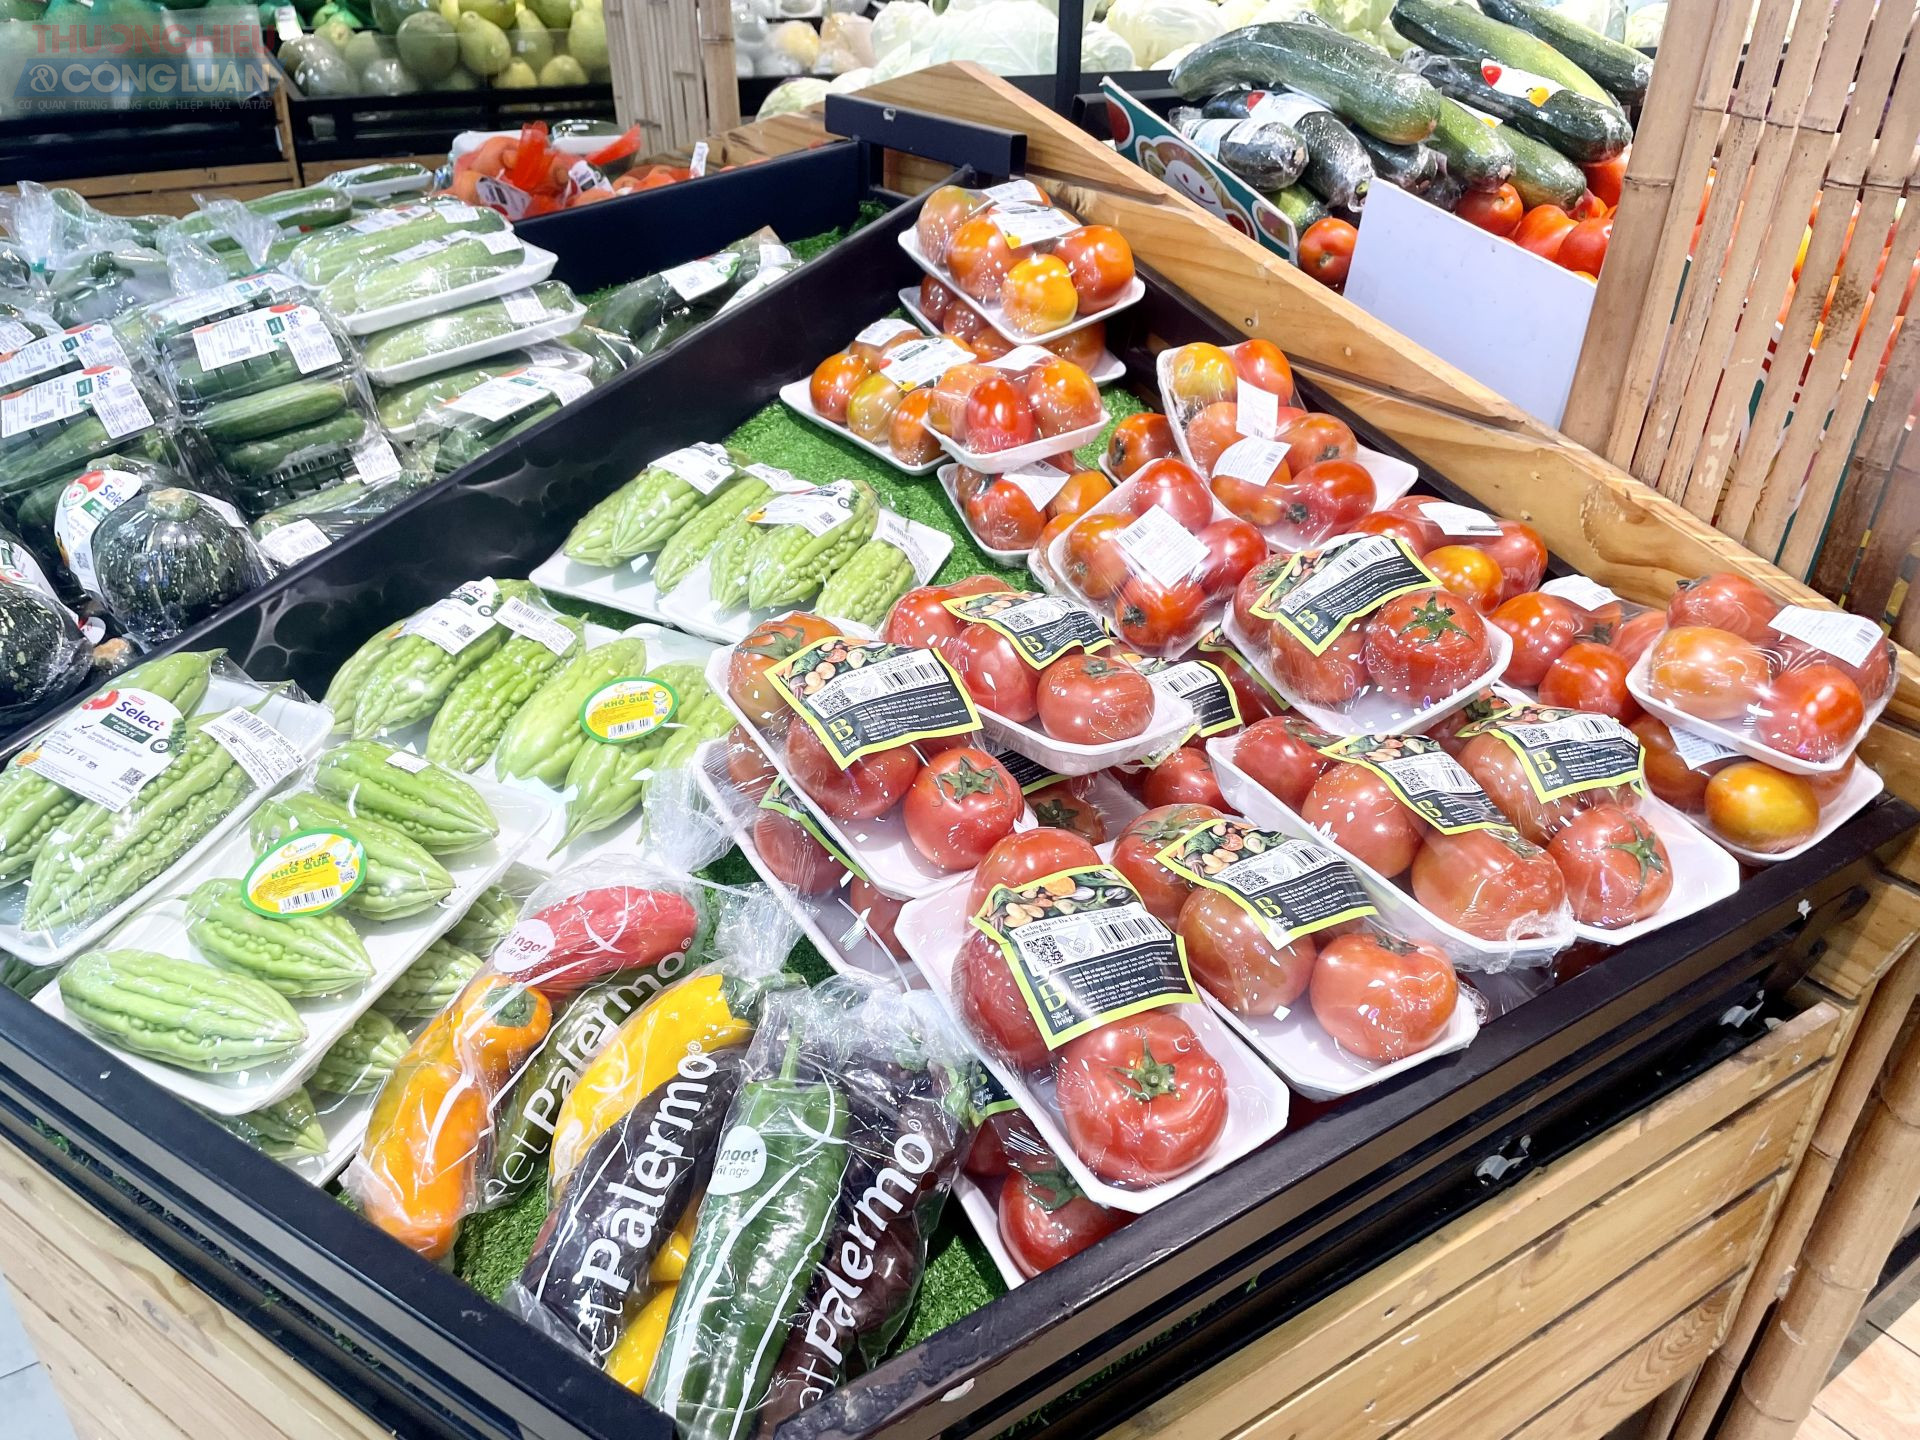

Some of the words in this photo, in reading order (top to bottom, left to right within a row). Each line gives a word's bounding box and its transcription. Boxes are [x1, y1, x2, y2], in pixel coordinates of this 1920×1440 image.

[115, 700, 165, 732] Select
[523, 950, 687, 1137] Palermo
[580, 1052, 718, 1293] Palermo
[805, 1133, 934, 1366] Palermo
